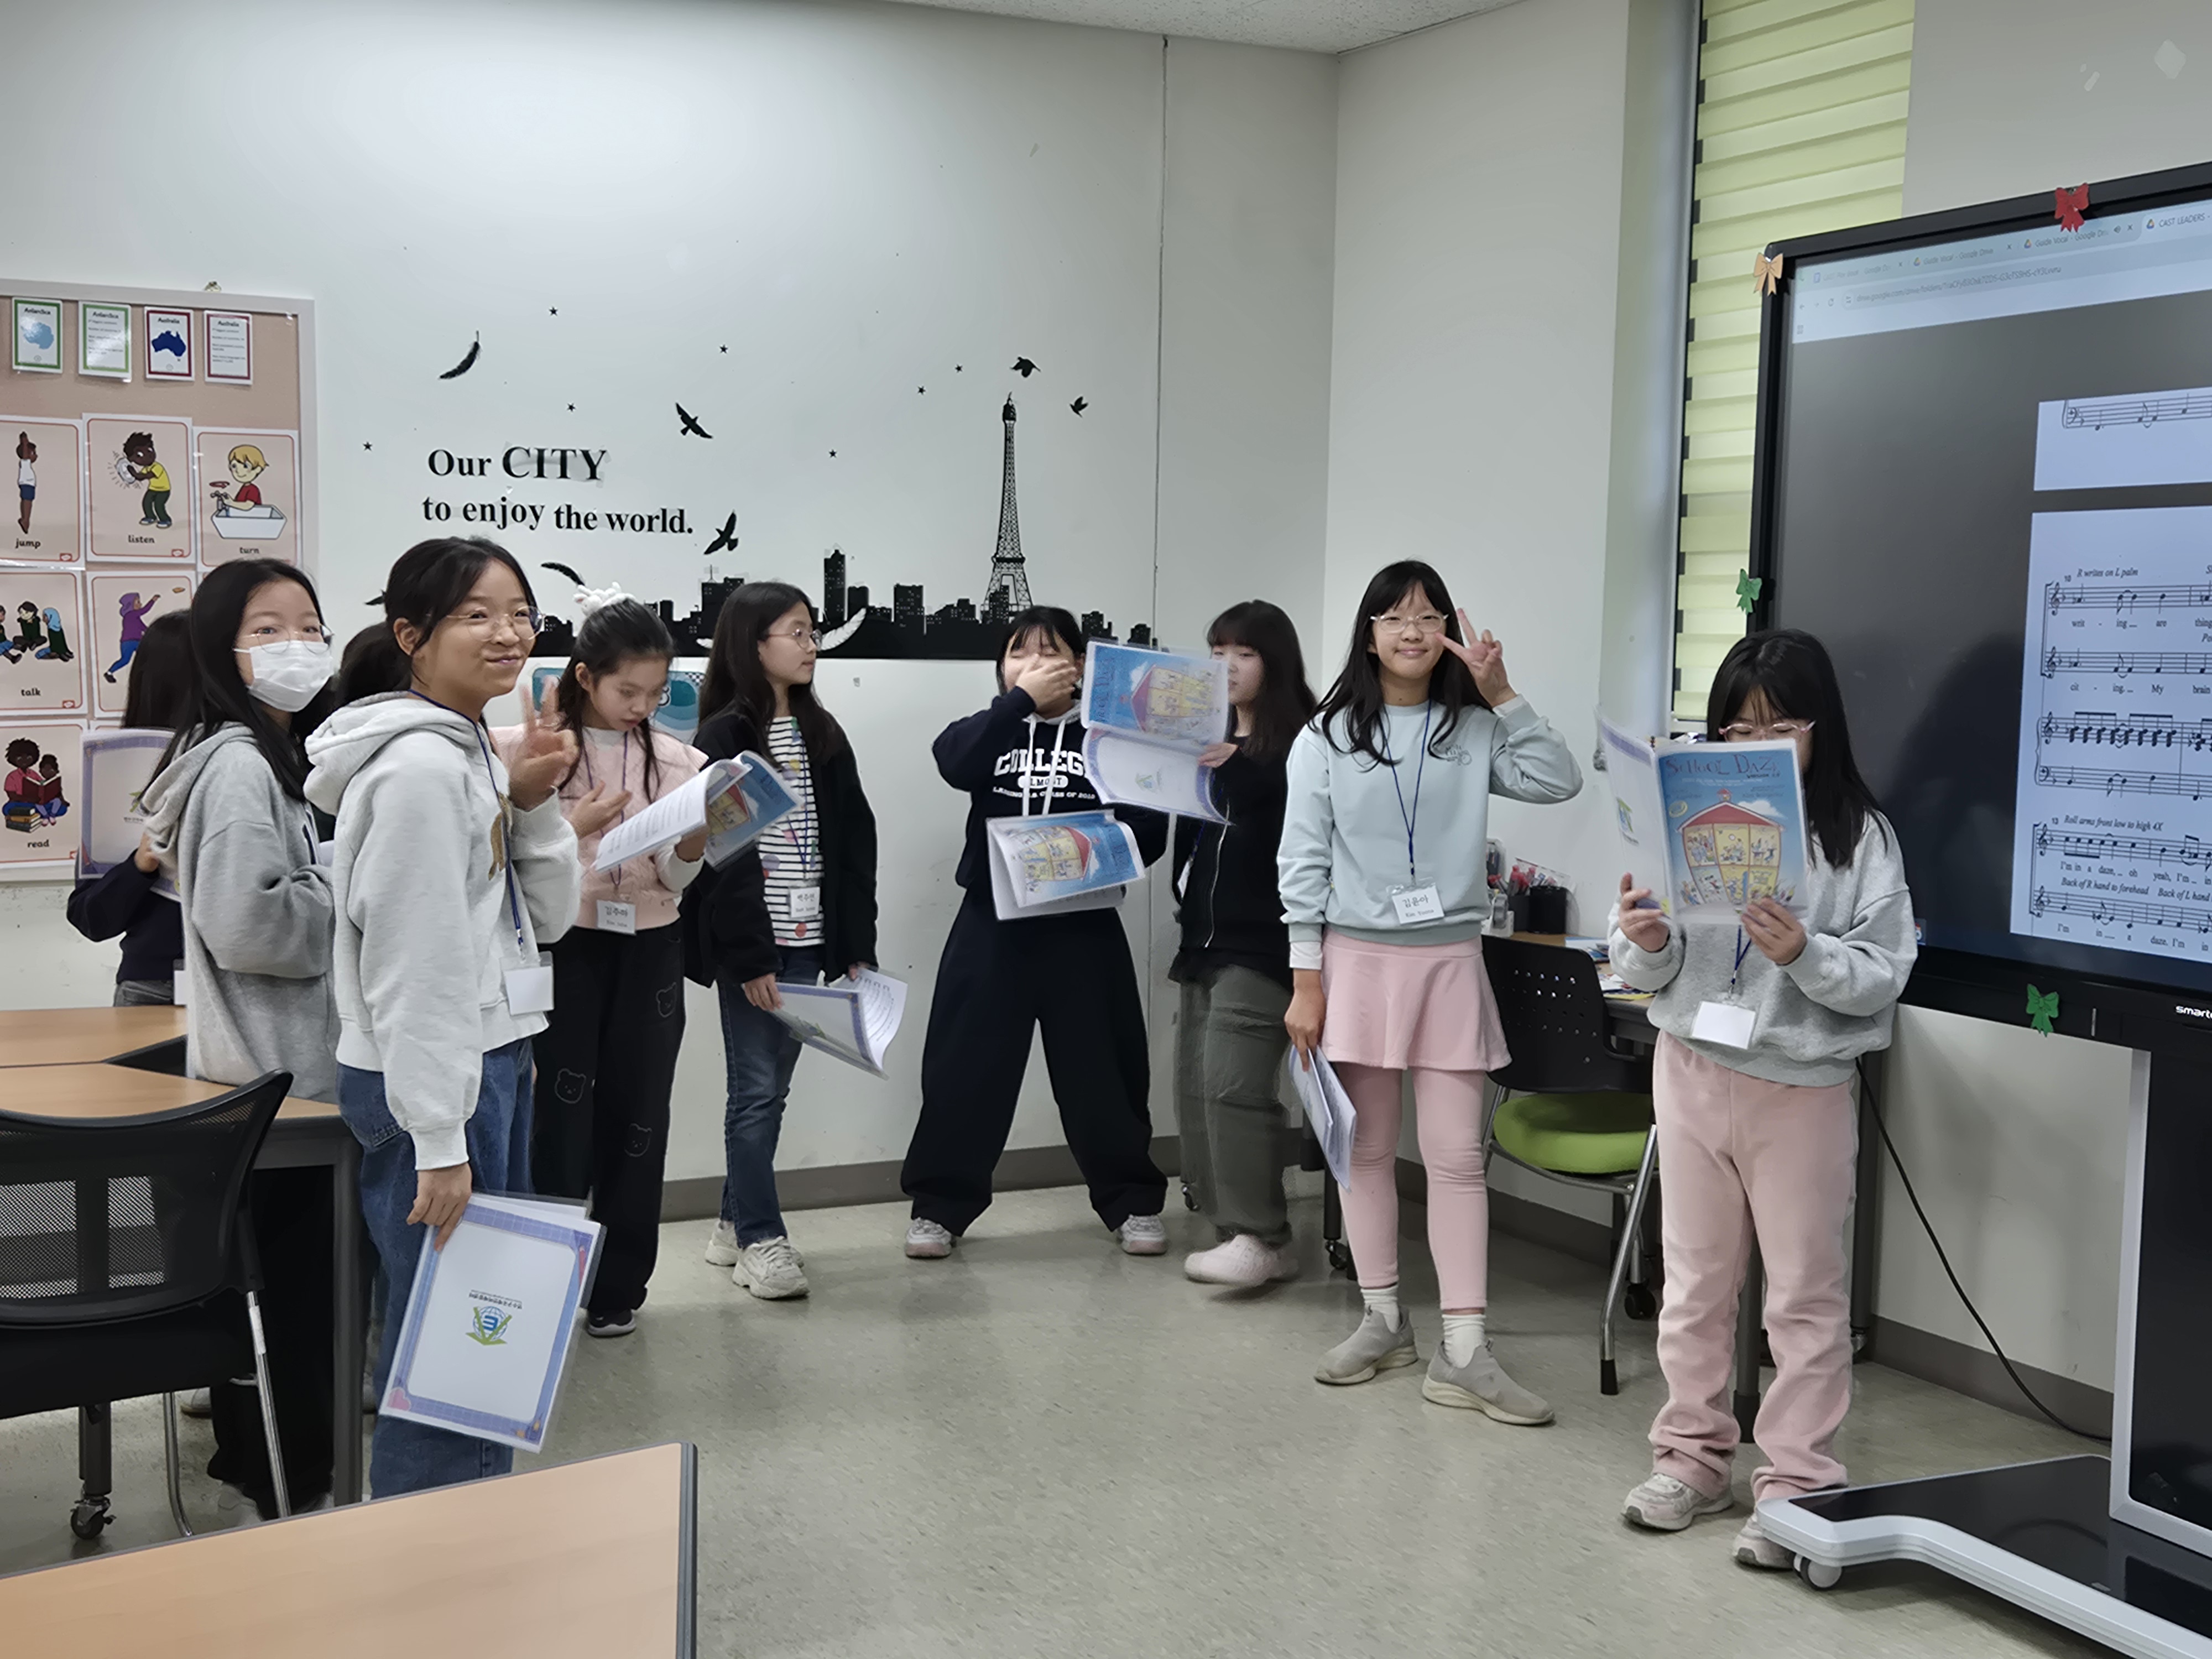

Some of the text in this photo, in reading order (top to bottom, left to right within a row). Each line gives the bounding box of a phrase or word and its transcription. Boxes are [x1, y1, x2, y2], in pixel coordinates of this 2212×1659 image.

[428, 446, 607, 481] Our CITY
[422, 496, 693, 534] to enjoy the world.
[15, 539, 41, 549] jump
[128, 535, 155, 544] listen
[239, 546, 260, 555] turn
[2084, 568, 2104, 577] writes
[2115, 567, 2120, 576] L
[2120, 567, 2138, 578] palm
[2116, 618, 2127, 629] ing
[21, 687, 41, 697] talk
[2151, 684, 2164, 695] My
[2193, 684, 2210, 694] brain
[2064, 815, 2078, 823] Roll
[2095, 817, 2113, 828] front
[2114, 818, 2126, 828] low
[2136, 821, 2151, 832] high
[27, 839, 50, 849] read
[2075, 862, 2081, 871] in
[2129, 868, 2138, 878] oh
[2153, 872, 2172, 882] yeah,
[2177, 873, 2189, 883] I'm
[2204, 875, 2211, 885] in
[2061, 877, 2077, 886] Back
[2078, 879, 2087, 890] of
[2086, 879, 2093, 889] R
[2094, 880, 2111, 890] hand
[2117, 883, 2150, 895] forehead
[2158, 887, 2210, 901] Back of L hand
[2057, 923, 2069, 933] I'm
[2096, 928, 2103, 937] in
[2172, 937, 2185, 948] I'm
[2201, 941, 2209, 951] in
